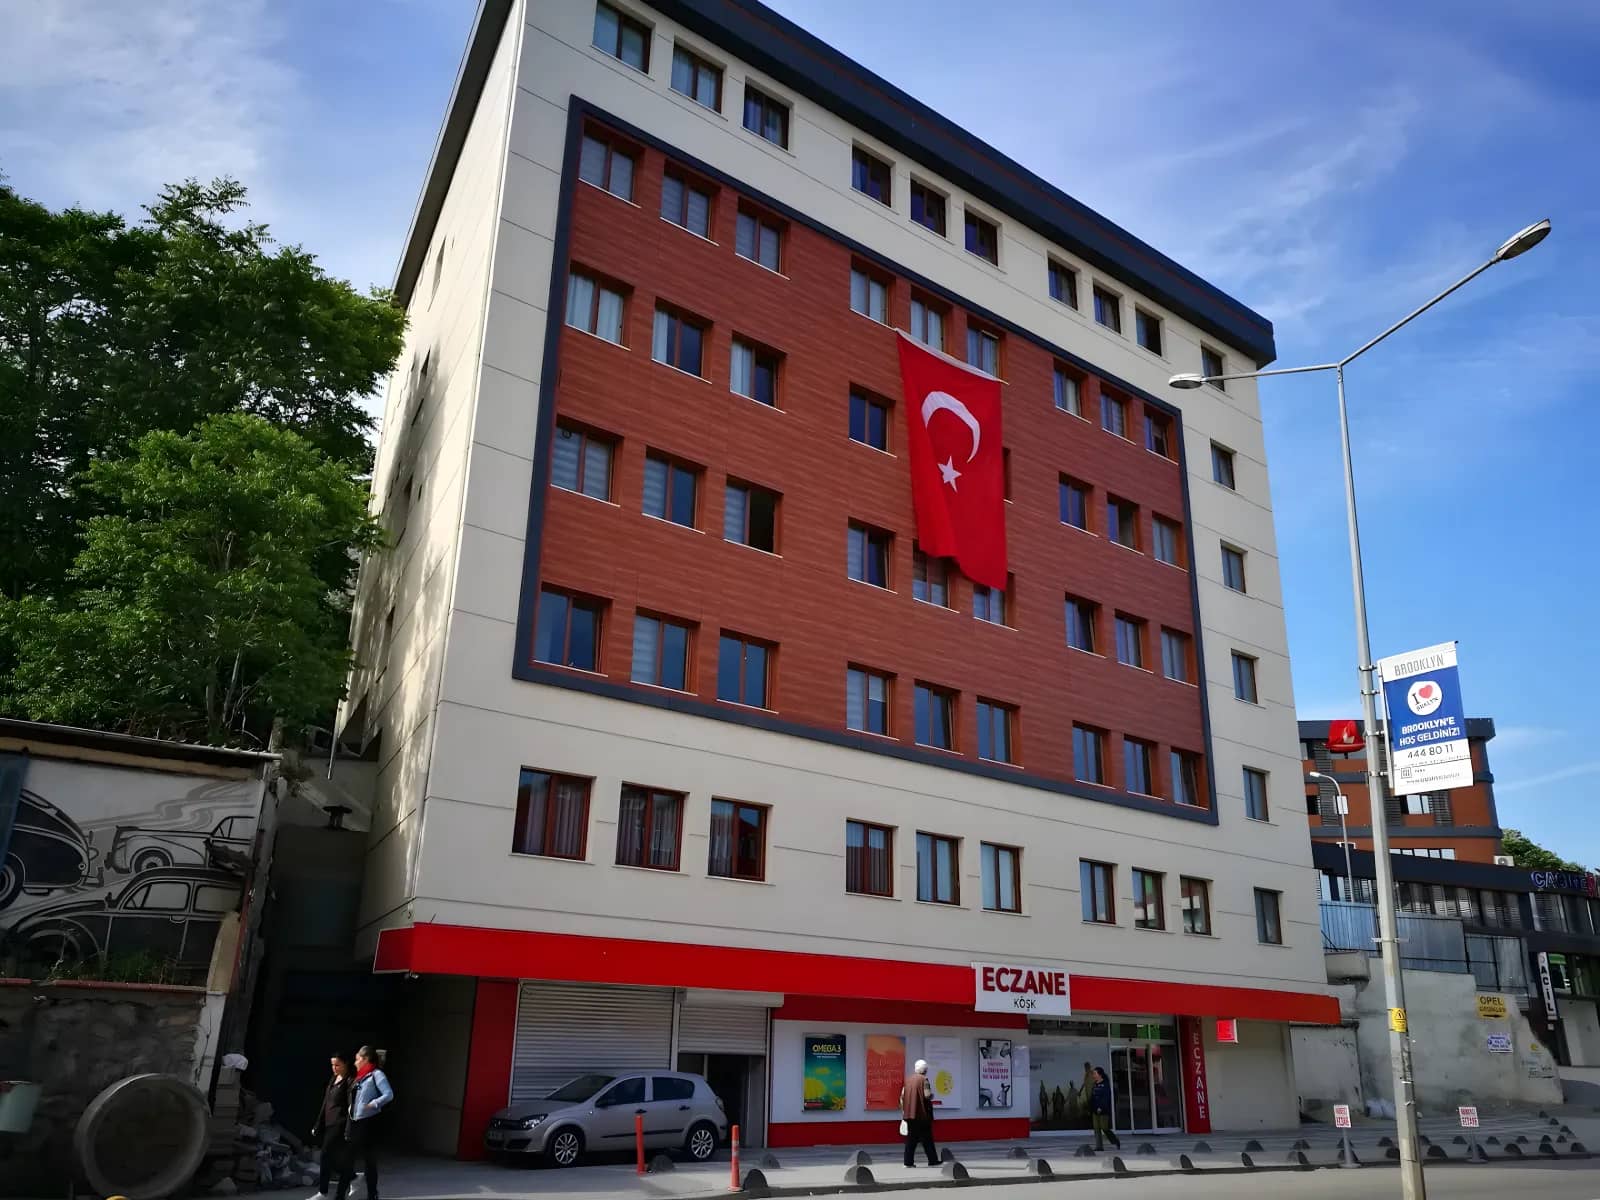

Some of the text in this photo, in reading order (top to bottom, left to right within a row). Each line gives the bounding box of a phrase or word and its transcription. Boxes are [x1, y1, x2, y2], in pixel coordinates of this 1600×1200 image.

[1394, 653, 1445, 676] BROOKLYN
[1412, 692, 1420, 705] I
[1402, 716, 1456, 735] BROOKLYN'E
[1399, 735, 1416, 747] HOŞ
[1407, 743, 1454, 759] 444 80 11
[982, 966, 1066, 995] ECZANE
[1541, 965, 1554, 1011] ACİL
[1013, 995, 1036, 1012] KÖŞK
[1479, 996, 1503, 1006] OPEL
[1192, 1032, 1206, 1119] ECZANE
